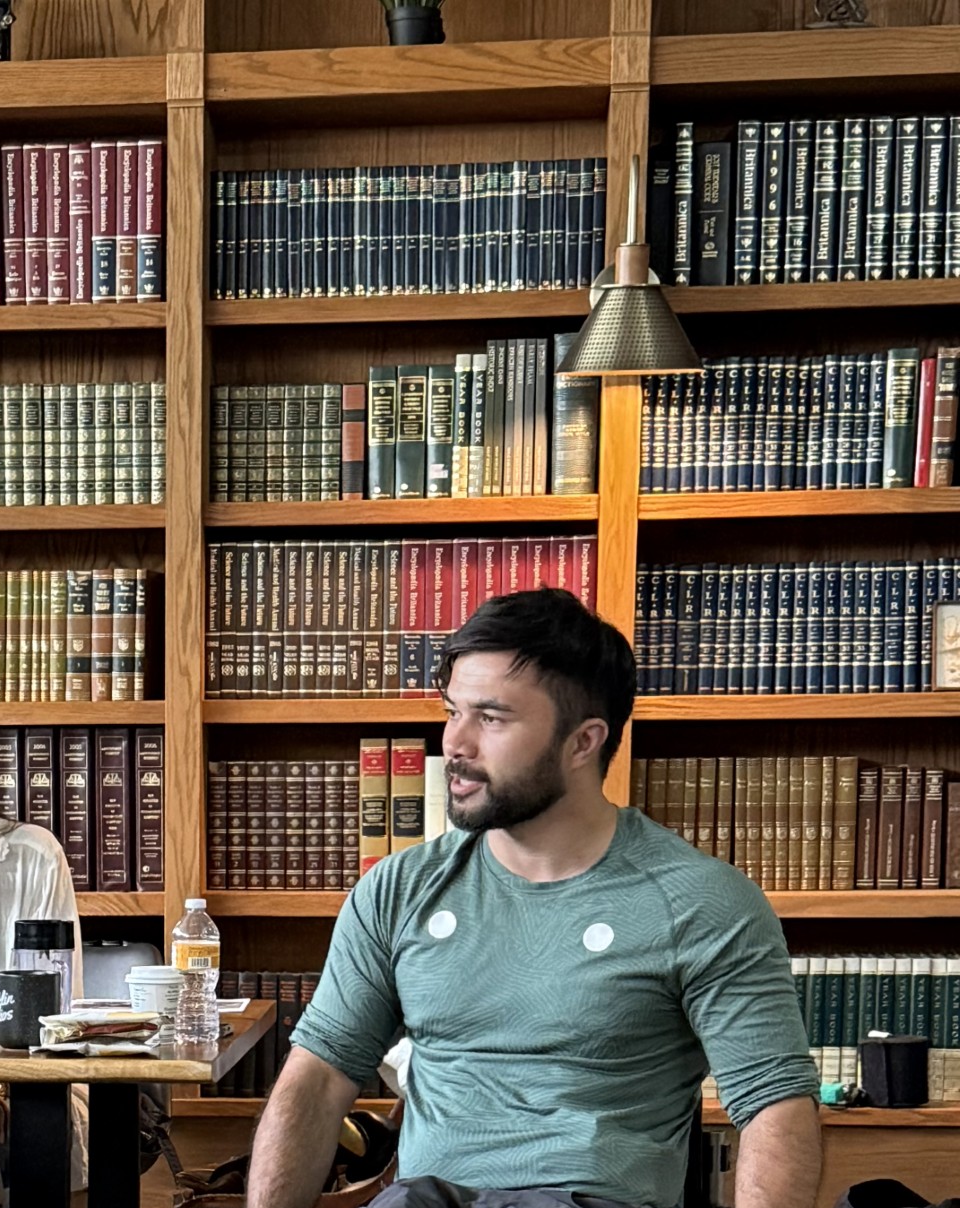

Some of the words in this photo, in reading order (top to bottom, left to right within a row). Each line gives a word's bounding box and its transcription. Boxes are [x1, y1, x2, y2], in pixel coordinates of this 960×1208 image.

[743, 149, 756, 210] Britannica
[794, 147, 808, 209] Britannica
[874, 145, 888, 207] Britannica
[902, 144, 915, 206] Britannica
[929, 144, 942, 206] Britannica
[676, 201, 687, 262] Britannica
[817, 198, 830, 260] Britannica
[845, 197, 858, 259] Britannica
[225, 552, 233, 576] Science
[289, 552, 297, 576] Science
[306, 552, 314, 575] Science
[323, 551, 331, 575] Science
[339, 551, 347, 576] Science
[390, 550, 399, 574] Science
